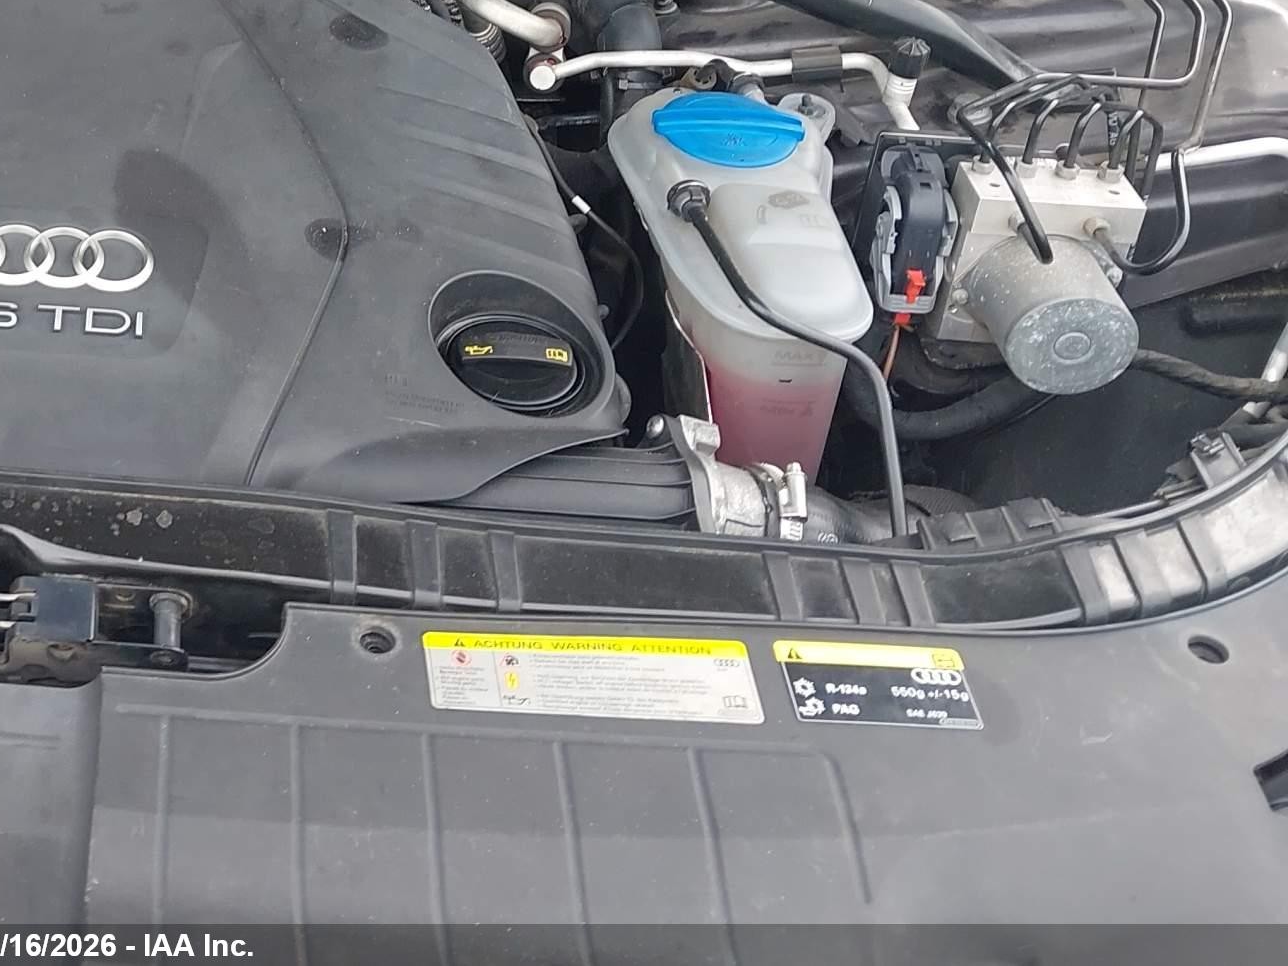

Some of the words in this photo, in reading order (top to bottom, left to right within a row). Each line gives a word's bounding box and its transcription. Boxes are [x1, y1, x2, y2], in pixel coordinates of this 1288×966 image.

[38, 304, 144, 338] TDI
[474, 639, 543, 650] ACHTUNG
[551, 641, 623, 652] WARNING
[632, 643, 711, 655] ATTENTION
